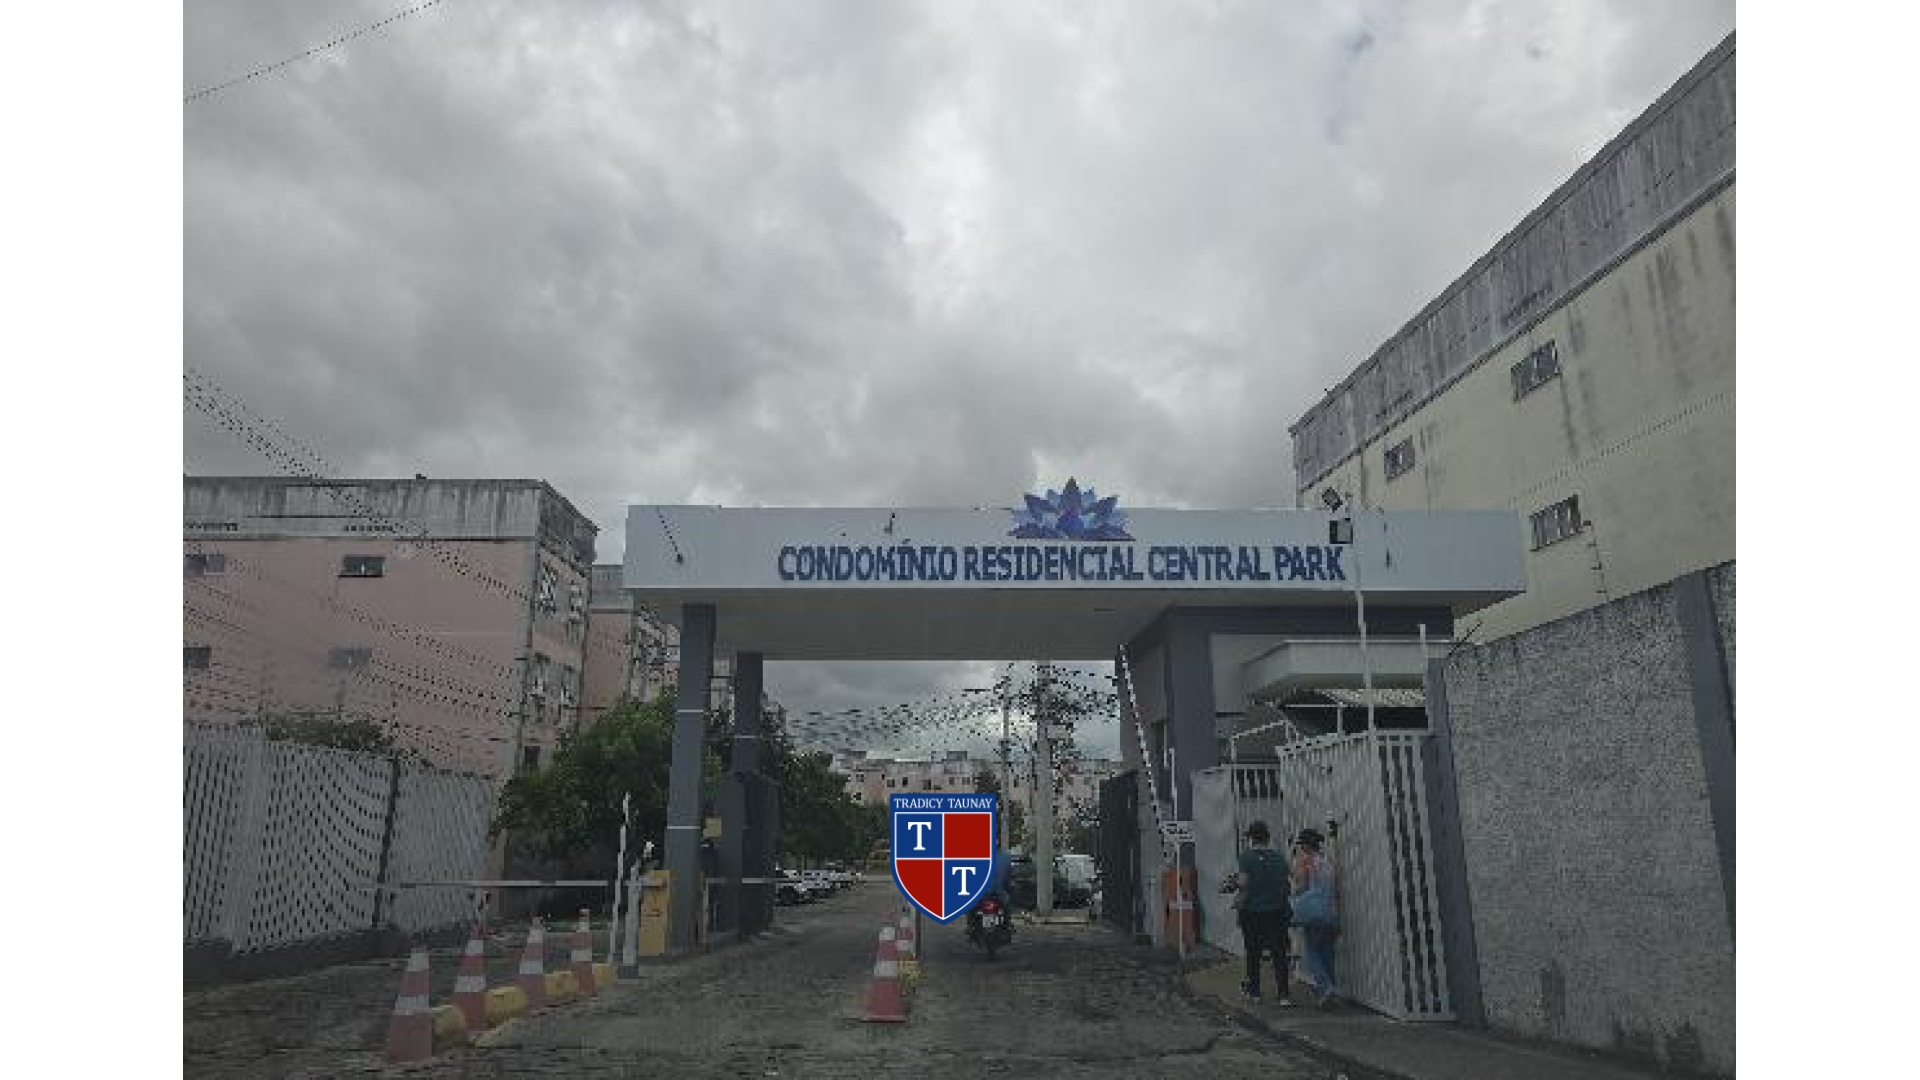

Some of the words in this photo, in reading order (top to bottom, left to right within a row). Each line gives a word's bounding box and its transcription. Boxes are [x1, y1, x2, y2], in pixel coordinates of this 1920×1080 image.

[778, 539, 957, 581] CONDOMÍNIO
[963, 546, 1143, 581] RESIDENCIAL
[1148, 546, 1271, 581] CENTRAL
[1274, 546, 1346, 581] PARK
